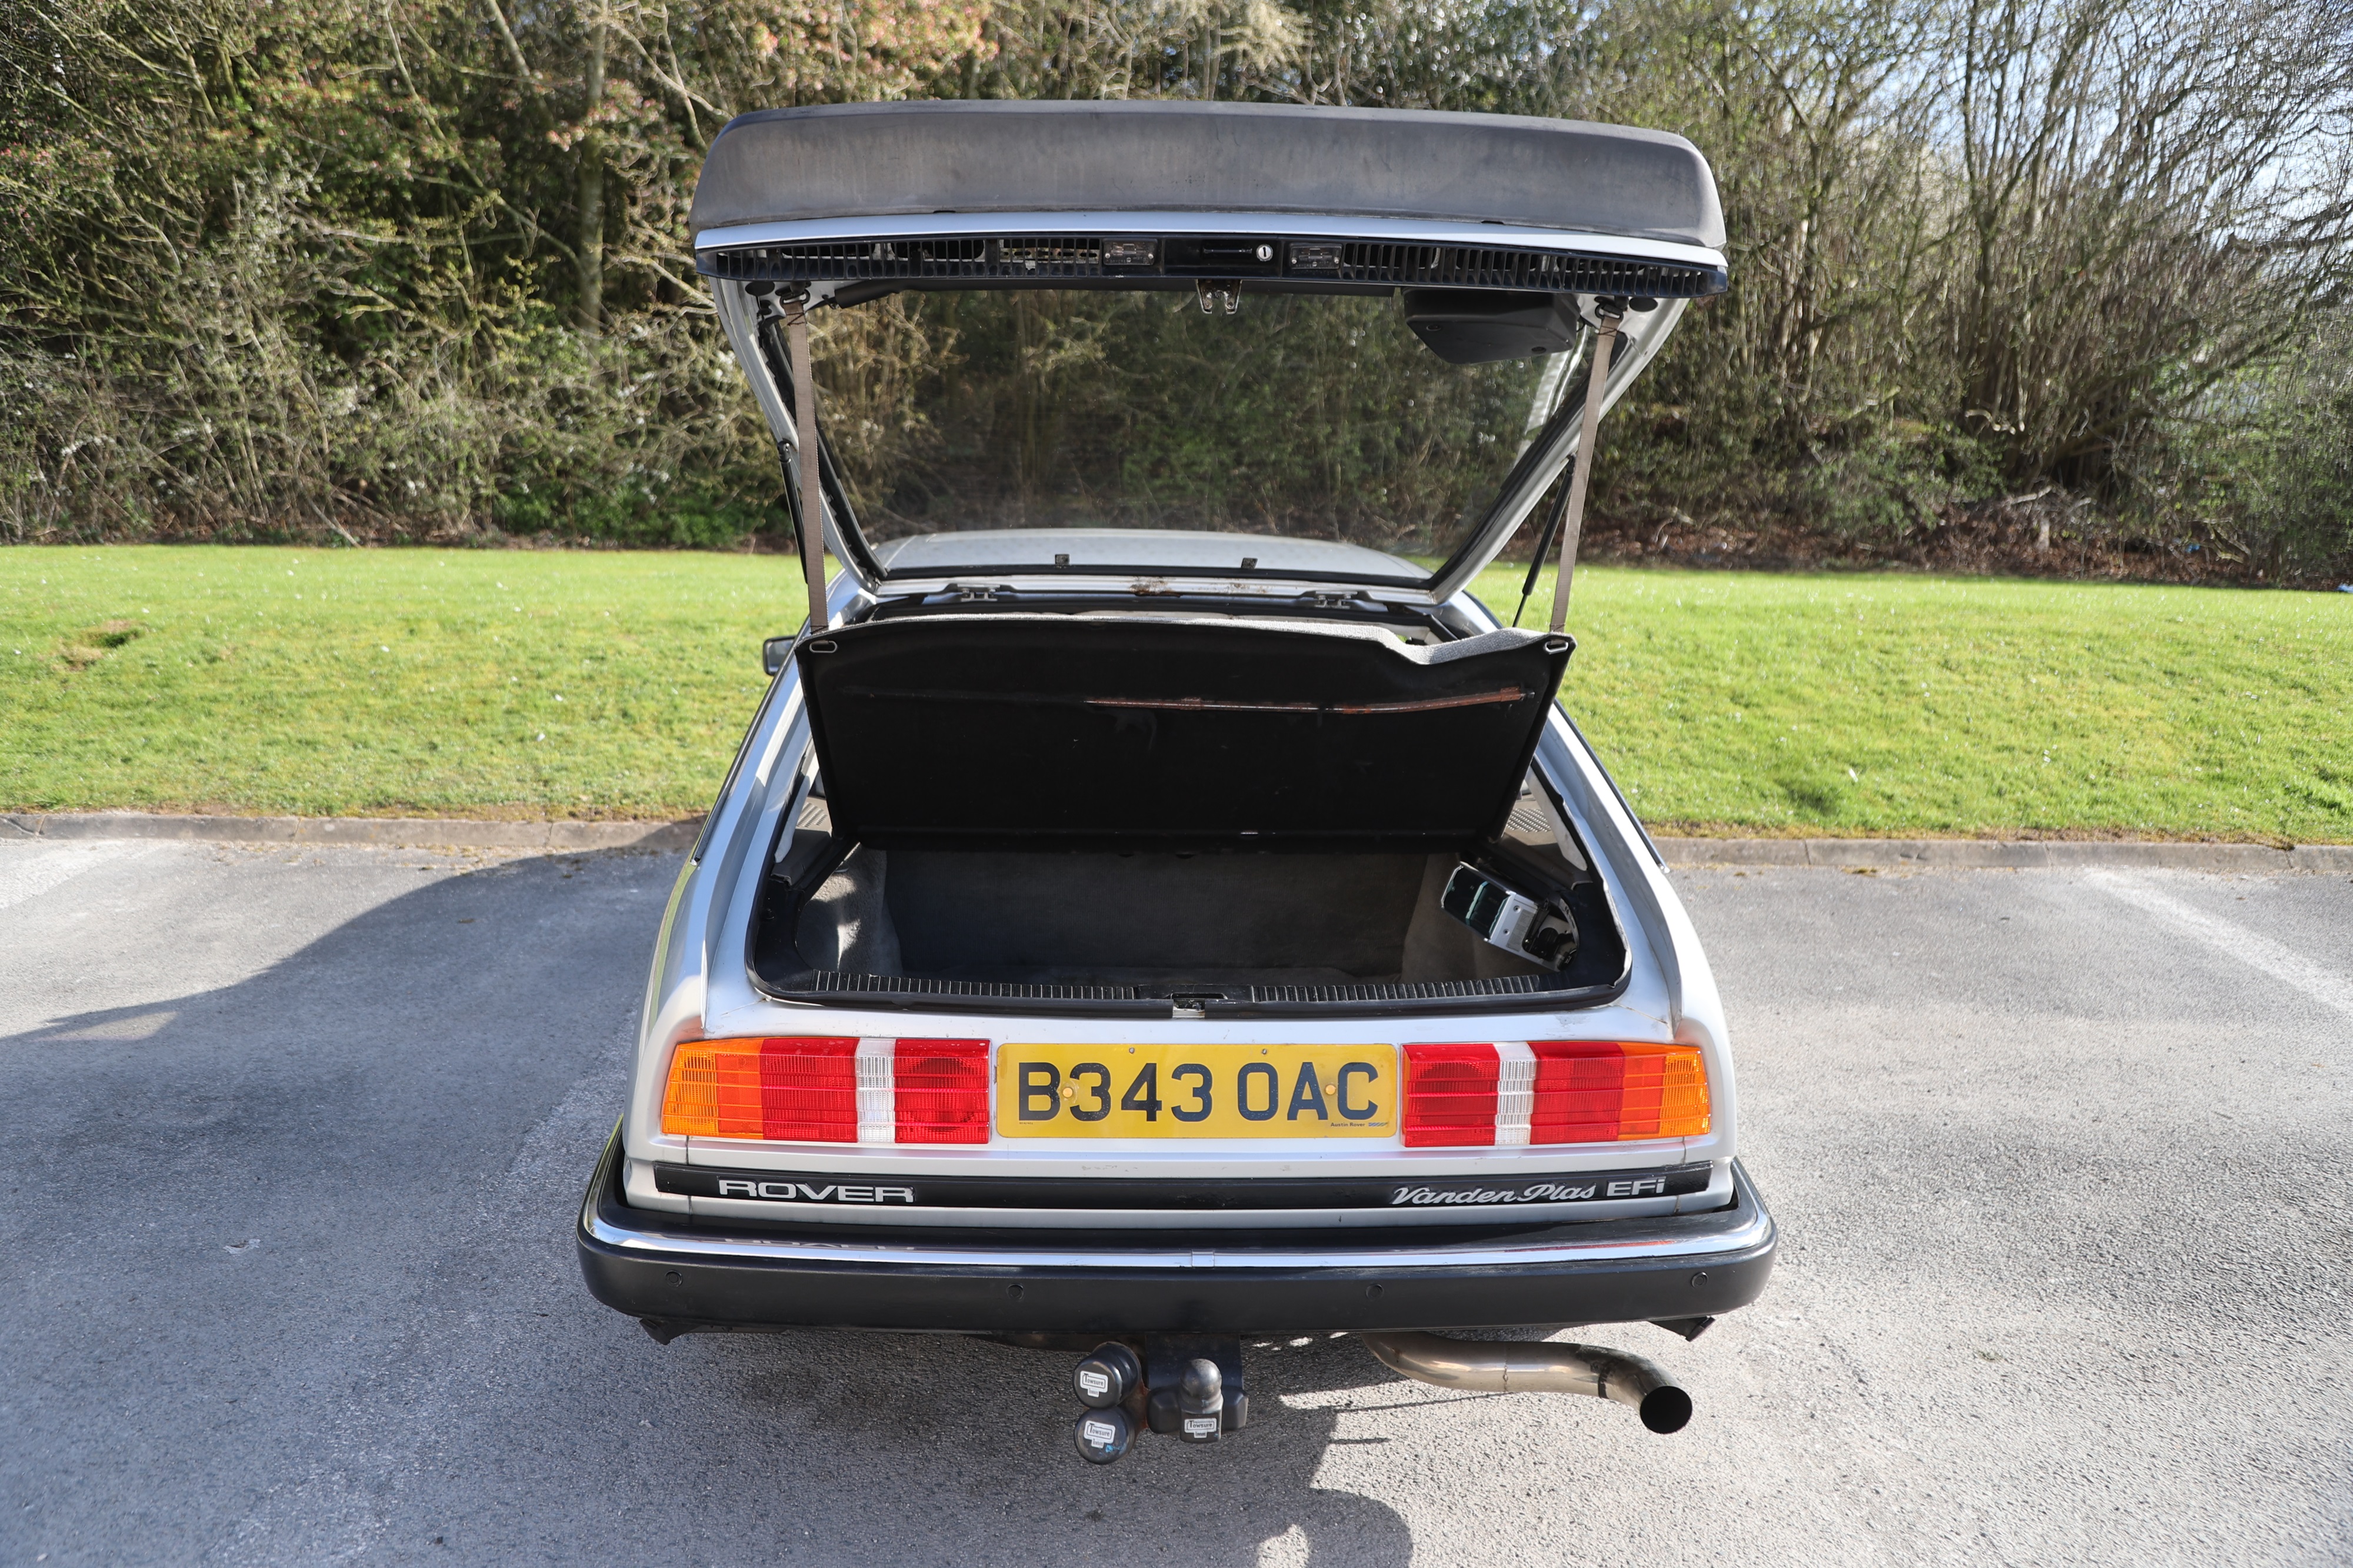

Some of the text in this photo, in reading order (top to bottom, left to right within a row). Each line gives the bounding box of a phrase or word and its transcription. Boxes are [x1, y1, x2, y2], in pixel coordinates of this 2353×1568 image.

[1018, 1062, 1379, 1122] B343 OAC
[718, 1179, 915, 1203] ROVER
[1389, 1176, 1667, 1205] Vanden Plas EFi
[1084, 1373, 1104, 1386] Towsure
[1089, 1423, 1110, 1437] Towsure
[1188, 1420, 1213, 1428] Towsure
